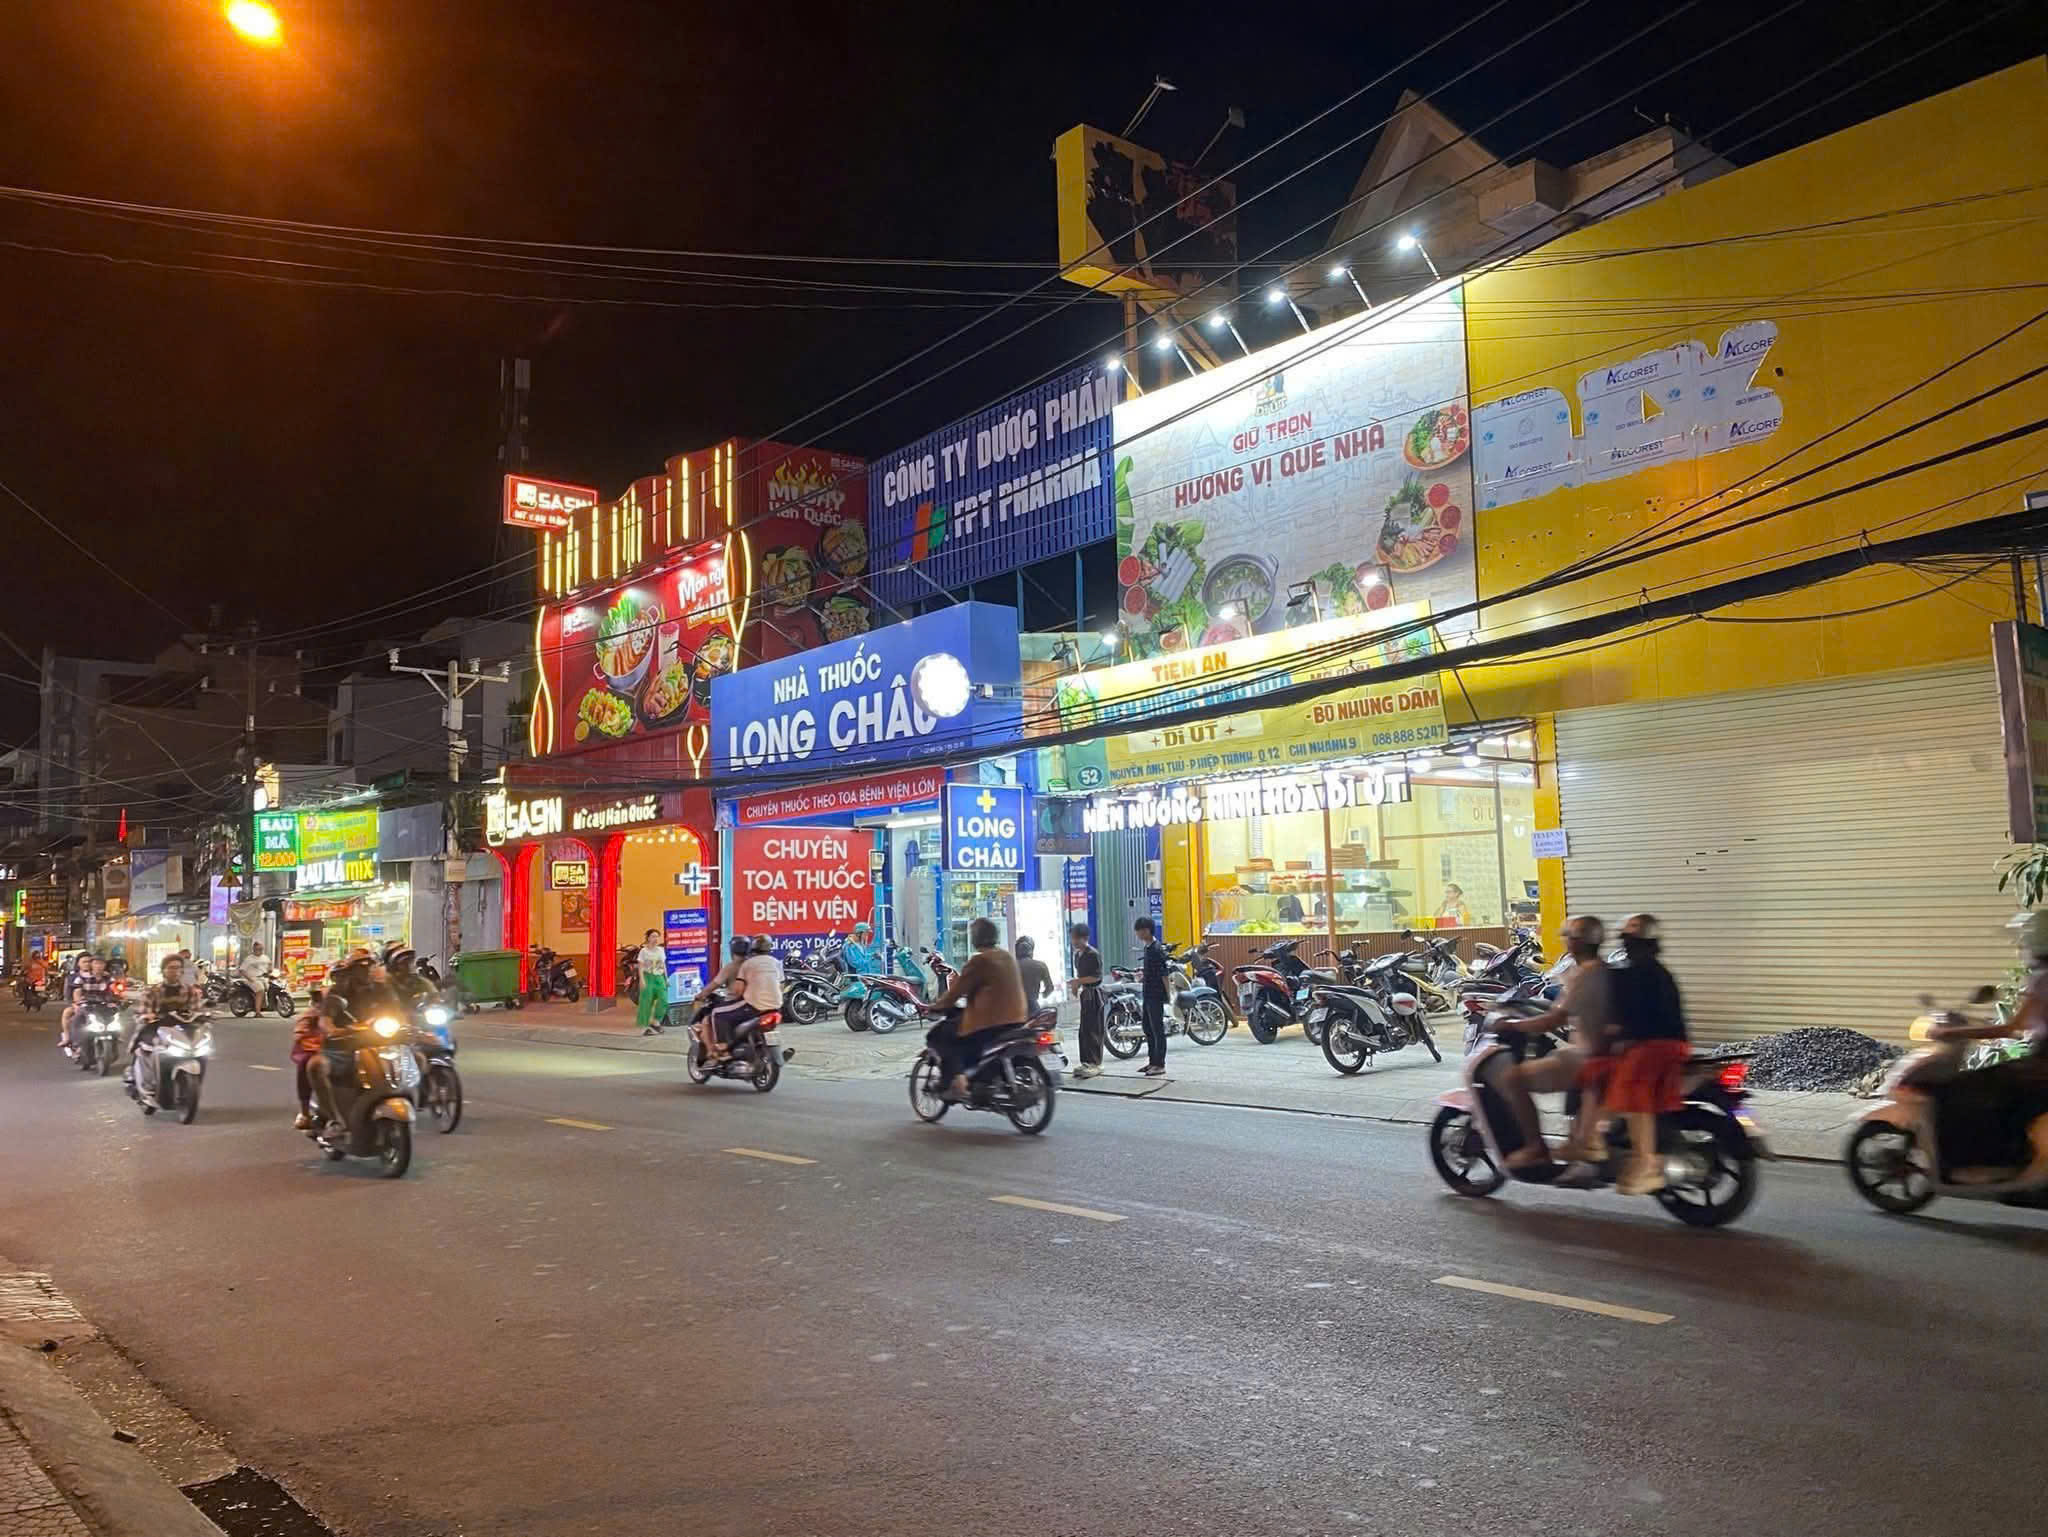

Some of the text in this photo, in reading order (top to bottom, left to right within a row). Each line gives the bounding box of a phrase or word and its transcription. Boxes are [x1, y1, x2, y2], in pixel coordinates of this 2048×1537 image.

[884, 459, 936, 507] CÔNG
[941, 438, 969, 483] TY
[976, 407, 1038, 470] DƯỢC
[953, 447, 1102, 539] FPT PHARMA
[773, 642, 882, 704] NHÀ THUỐC
[729, 709, 816, 772] LONG
[1289, 742, 1307, 757] CHI
[1348, 737, 1357, 749] 9
[1081, 768, 1101, 785] 52
[1267, 748, 1280, 759] 12
[812, 793, 837, 810] THEO
[838, 791, 857, 805] TOA
[859, 784, 885, 806] BỆNH
[957, 816, 1016, 839] LONG
[763, 835, 848, 860] CHUYÊN
[958, 841, 1017, 868] CHÂU
[346, 853, 375, 881] mix
[743, 862, 866, 891] TOA THUỐC
[752, 895, 858, 927] BỆNH VIỆN
